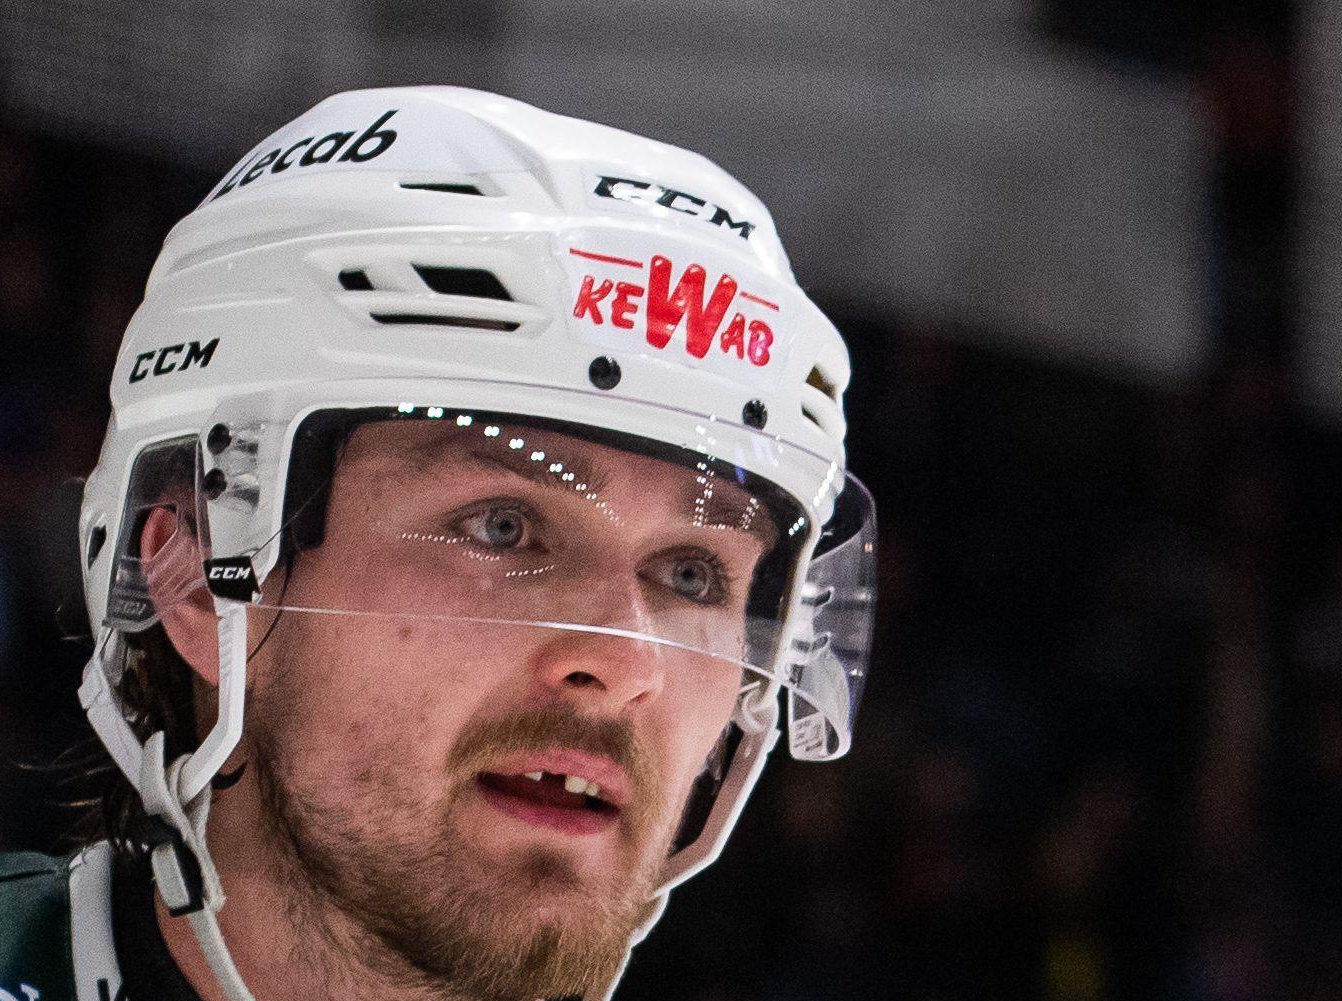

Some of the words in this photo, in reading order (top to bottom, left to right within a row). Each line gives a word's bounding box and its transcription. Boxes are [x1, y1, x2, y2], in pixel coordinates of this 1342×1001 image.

[594, 174, 756, 240] CCM
[129, 337, 220, 384] CCM
[209, 566, 252, 580] CCM
